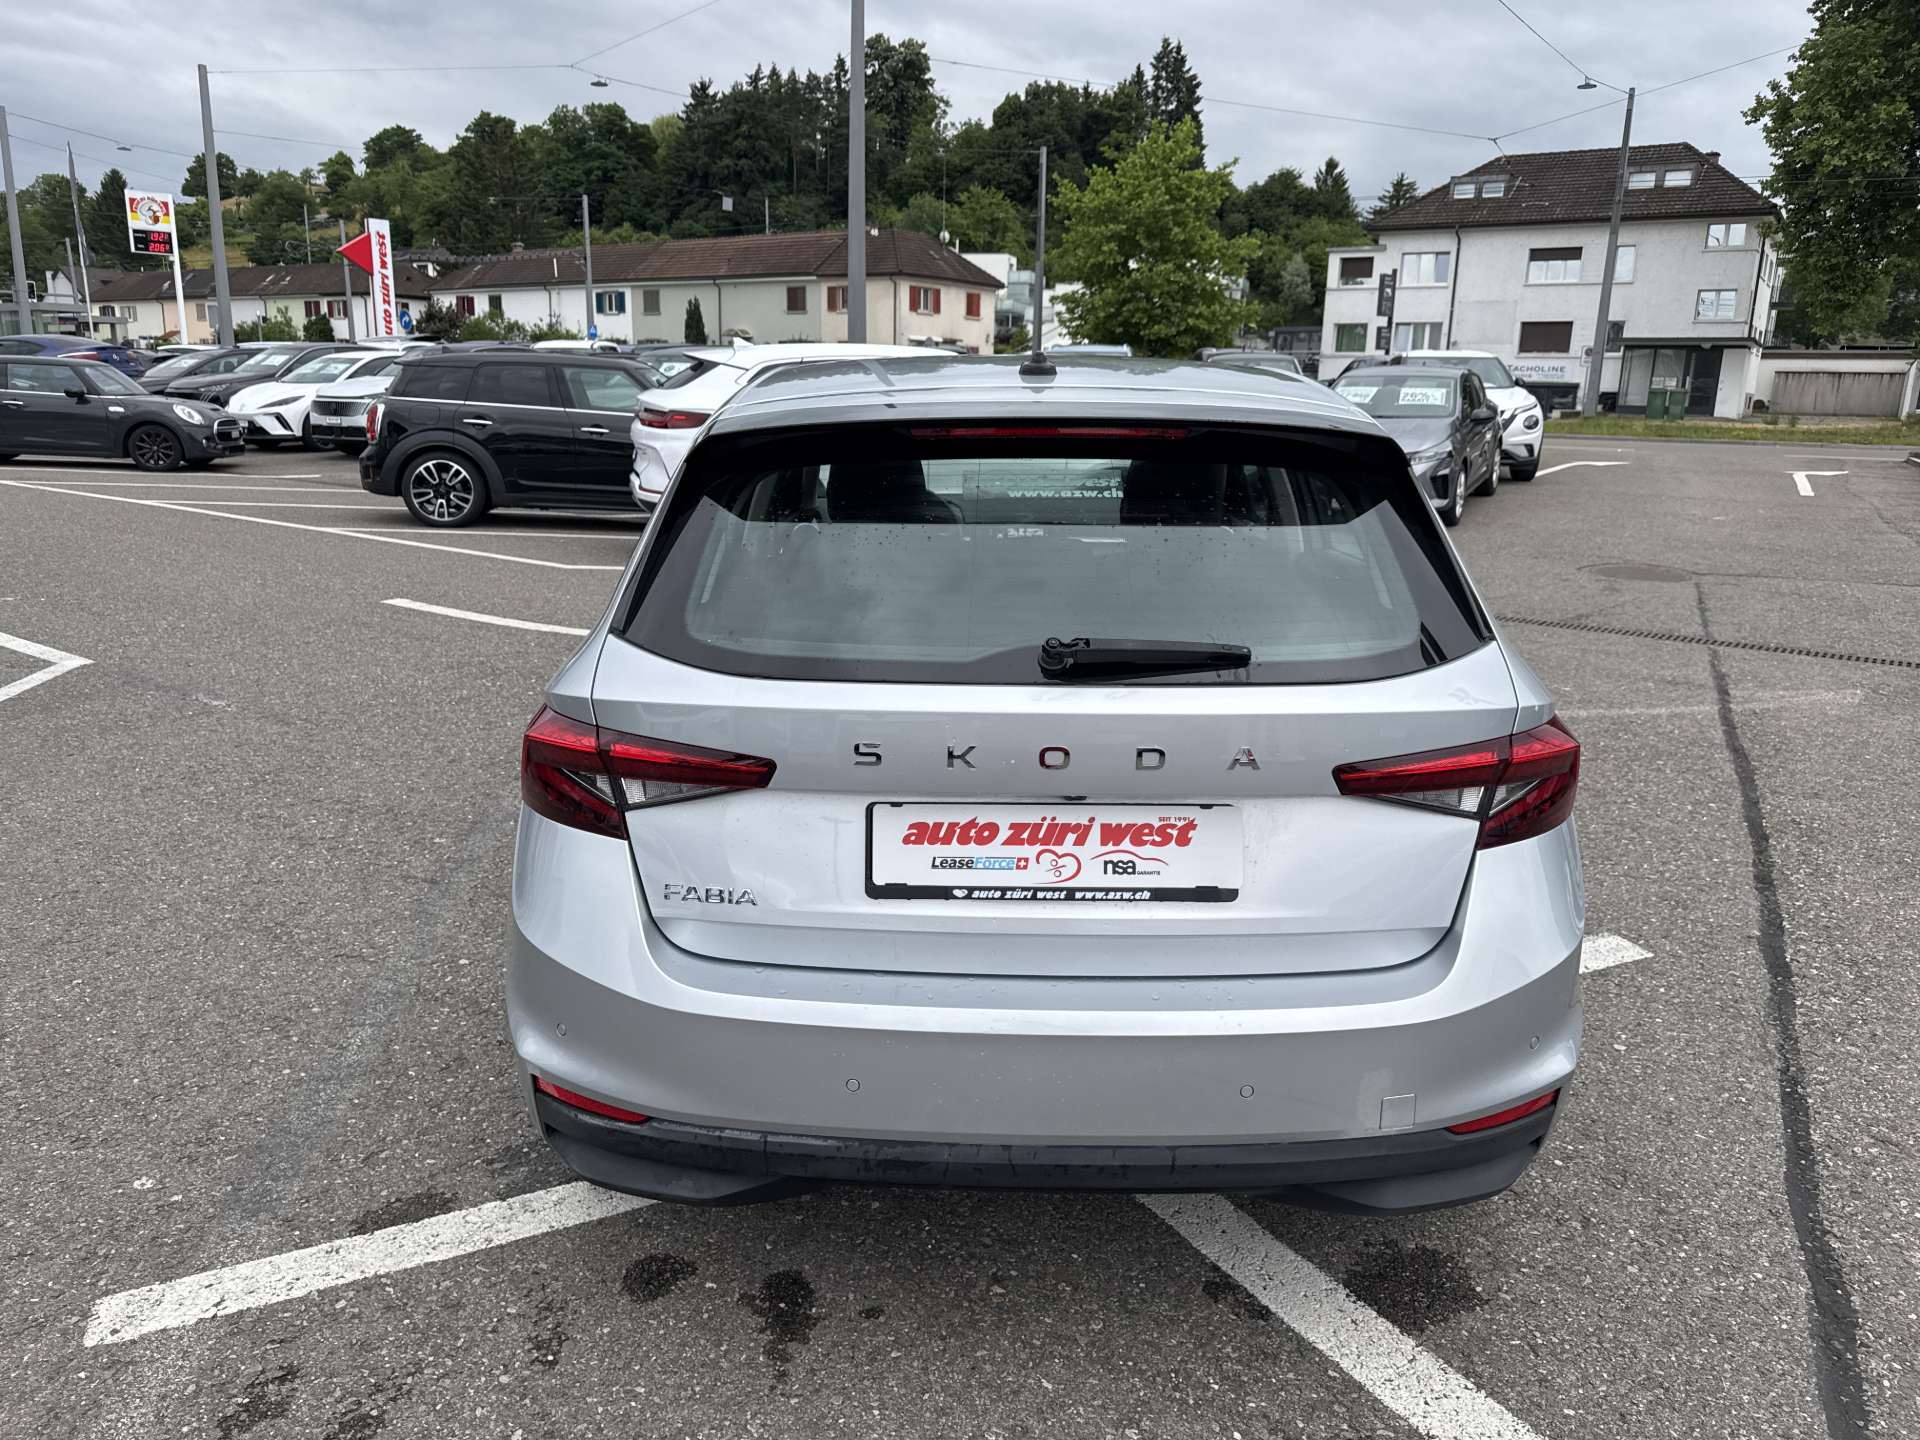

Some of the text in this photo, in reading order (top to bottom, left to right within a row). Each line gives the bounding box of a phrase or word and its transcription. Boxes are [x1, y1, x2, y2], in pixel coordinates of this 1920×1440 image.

[375, 230, 389, 269] west
[1506, 364, 1567, 373] TACHOLINE
[1007, 487, 1124, 498] www.azw.ch
[902, 815, 1199, 847] auto züri west
[931, 856, 1016, 870] LeaseForce
[1103, 859, 1137, 876] nsa
[663, 882, 759, 906] FABIA
[971, 888, 1151, 900] auto züri west www.azw.ch
